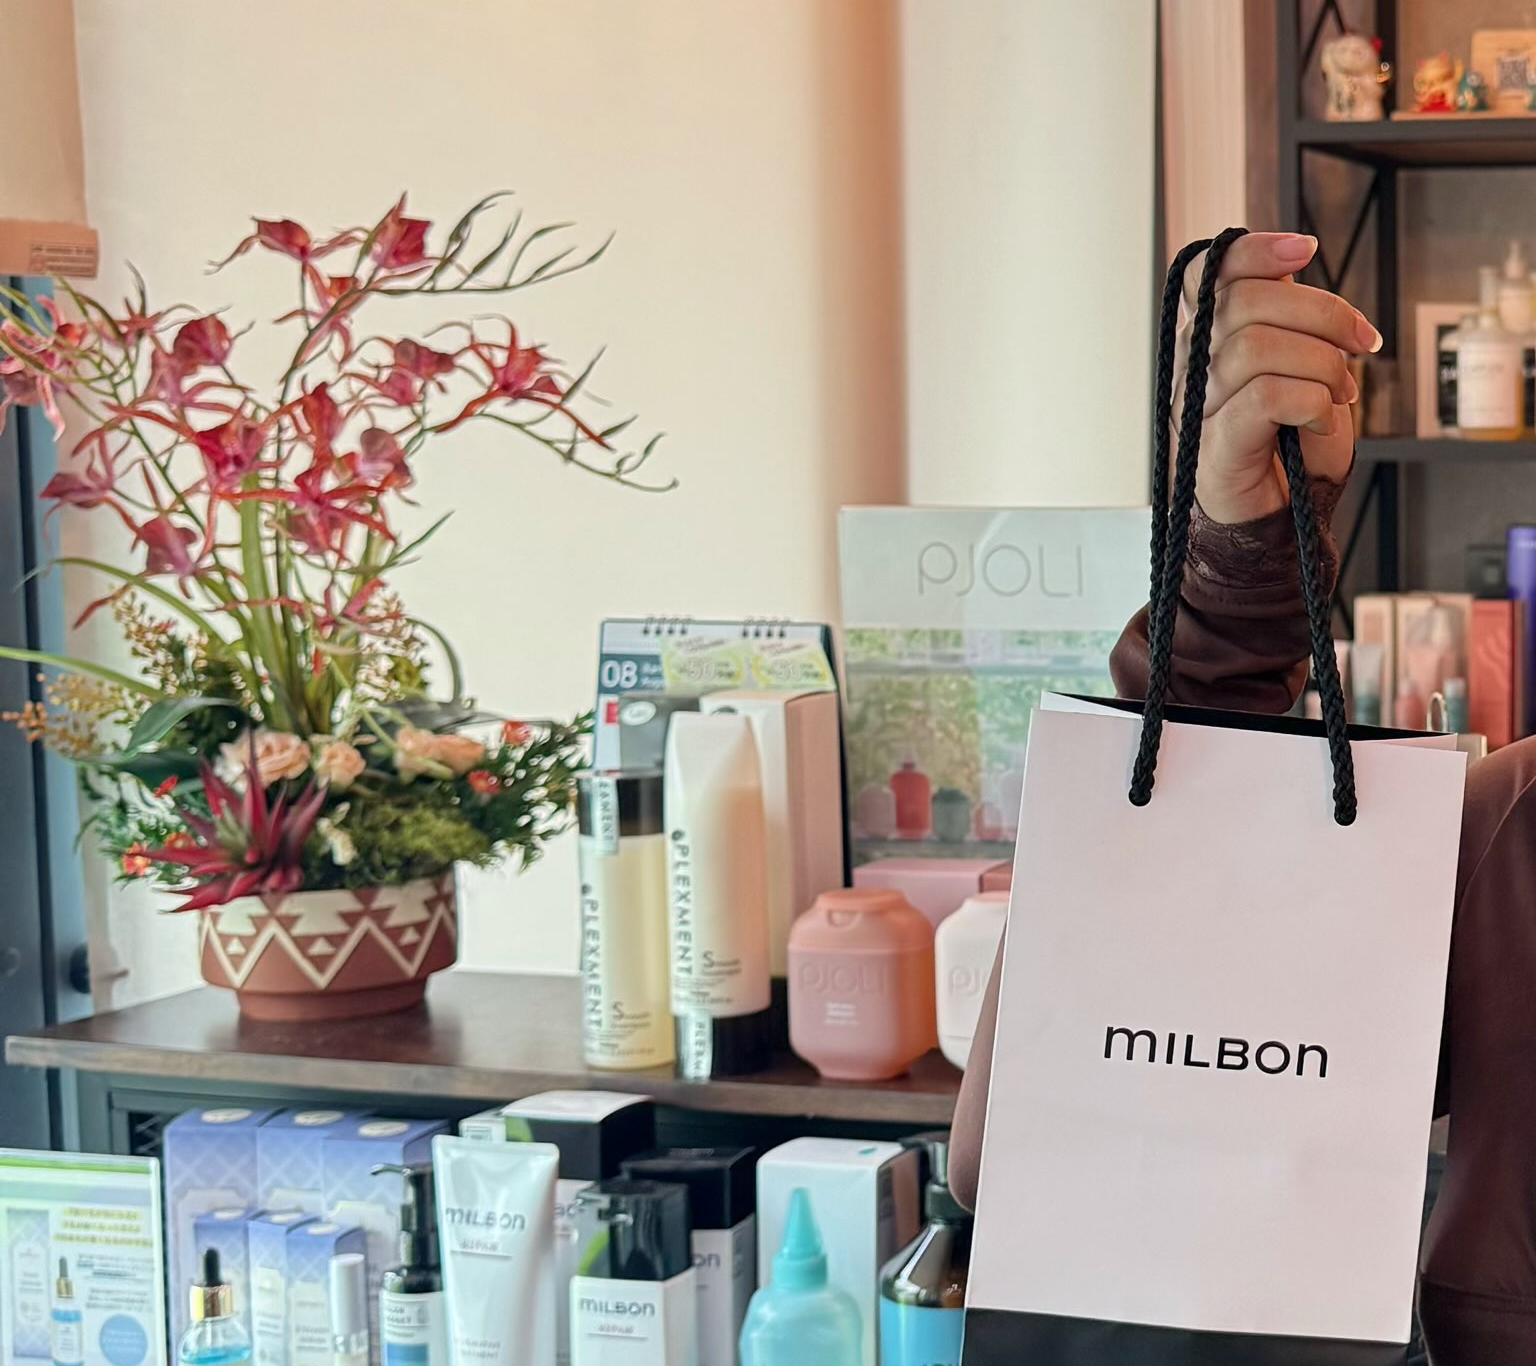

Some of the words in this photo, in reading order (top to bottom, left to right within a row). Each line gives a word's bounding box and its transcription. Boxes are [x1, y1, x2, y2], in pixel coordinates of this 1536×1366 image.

[917, 540, 1084, 598] PJOLI
[601, 659, 639, 688] 08
[673, 843, 693, 975] PLEXMENT
[582, 898, 603, 1029] PLEXMENT
